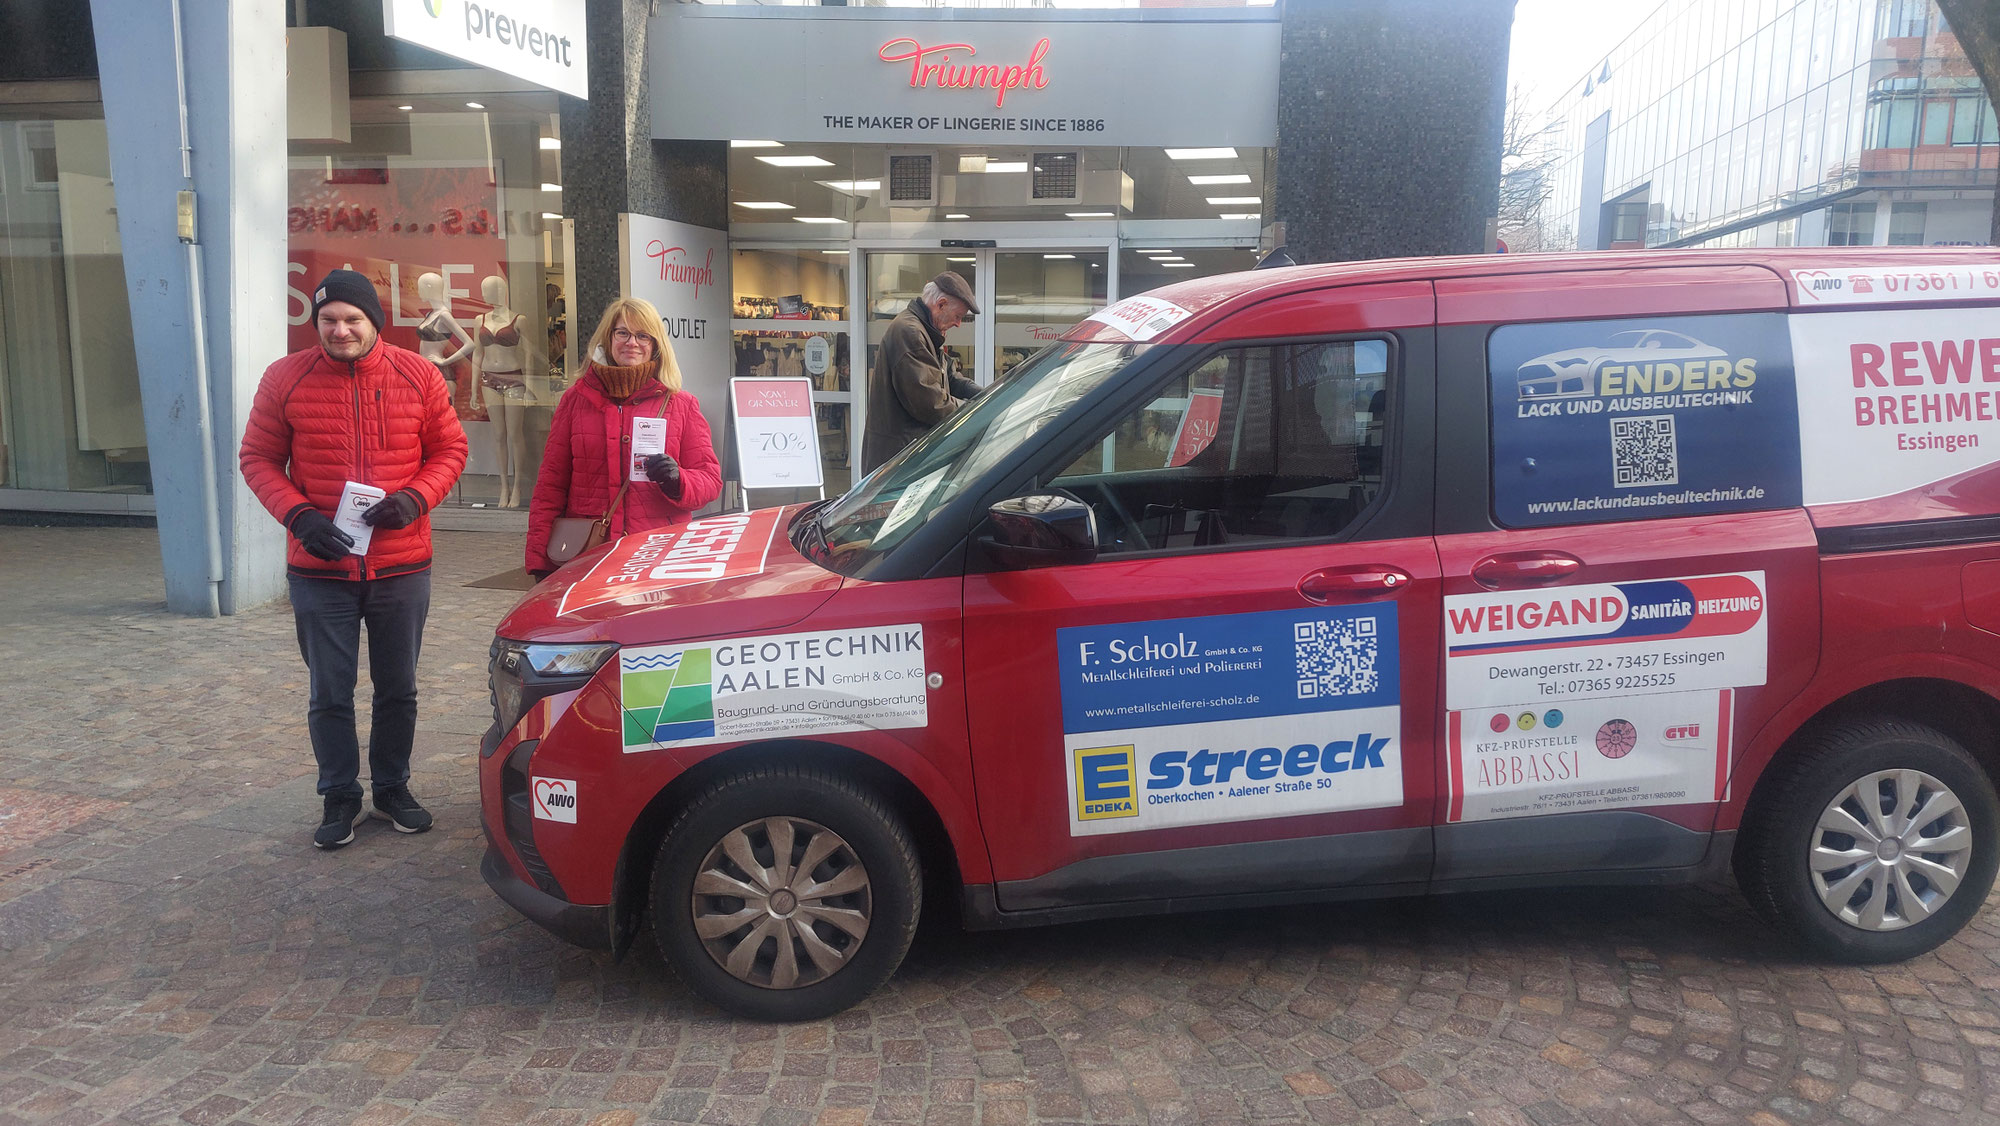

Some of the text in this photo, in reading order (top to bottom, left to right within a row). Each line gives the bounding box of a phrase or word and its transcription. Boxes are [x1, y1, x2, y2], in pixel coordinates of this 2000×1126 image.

[464, 2, 572, 68] prevent
[879, 37, 1052, 109] Triumph
[823, 115, 1105, 132] THE MAKER OF LINGERIE SINCE 1886
[646, 239, 715, 300] Triumph
[1813, 278, 1842, 291] AWO
[1883, 272, 1959, 293] 07361
[1983, 270, 2000, 289] 6
[287, 263, 475, 327] SLE
[662, 317, 707, 340] OUTLET
[1025, 325, 1062, 341] Trium
[1600, 357, 1758, 397] ENDERS
[1850, 338, 2000, 388] REWE
[1517, 389, 1753, 418] LACK UND AUSBEULTECHNIK
[1855, 391, 2000, 427] BREHME
[1192, 418, 1217, 438] SAL
[1897, 431, 1979, 453] Essingen
[1527, 485, 1765, 514] www.lackundausbeultechnik.de
[1448, 595, 1761, 635] WEIGAND SANITÄR HEIZUNG
[716, 630, 922, 667] GEOTECHNIK
[1079, 641, 1101, 667] F.
[1110, 632, 1200, 664] Scholz
[1205, 648, 1228, 657] GmbH
[1252, 645, 1263, 653] KG
[1489, 650, 1725, 680] Dewangerstr. 22 73457 Essingen
[717, 665, 925, 695] AALEN GmbH & Co. KG
[1538, 673, 1676, 696] Tel.: 07365 9225525
[717, 694, 926, 719] Baugrund- und Gründungsberatung
[1085, 693, 1260, 718] www.metallschleiferei-scholz.de
[1476, 735, 1578, 754] KFZ-PRÜFSTELLE
[1665, 723, 1700, 739] GTÜ
[1146, 733, 1392, 790] Streeck
[1478, 750, 1580, 788] ABBASSI
[547, 793, 575, 809] AWO
[1148, 778, 1332, 805] Oberkochen Aalener Straße 50
[1538, 786, 1640, 801] KFZ-PRÜFSTELLE ABBASSI
[1085, 802, 1133, 815] EDEKA
